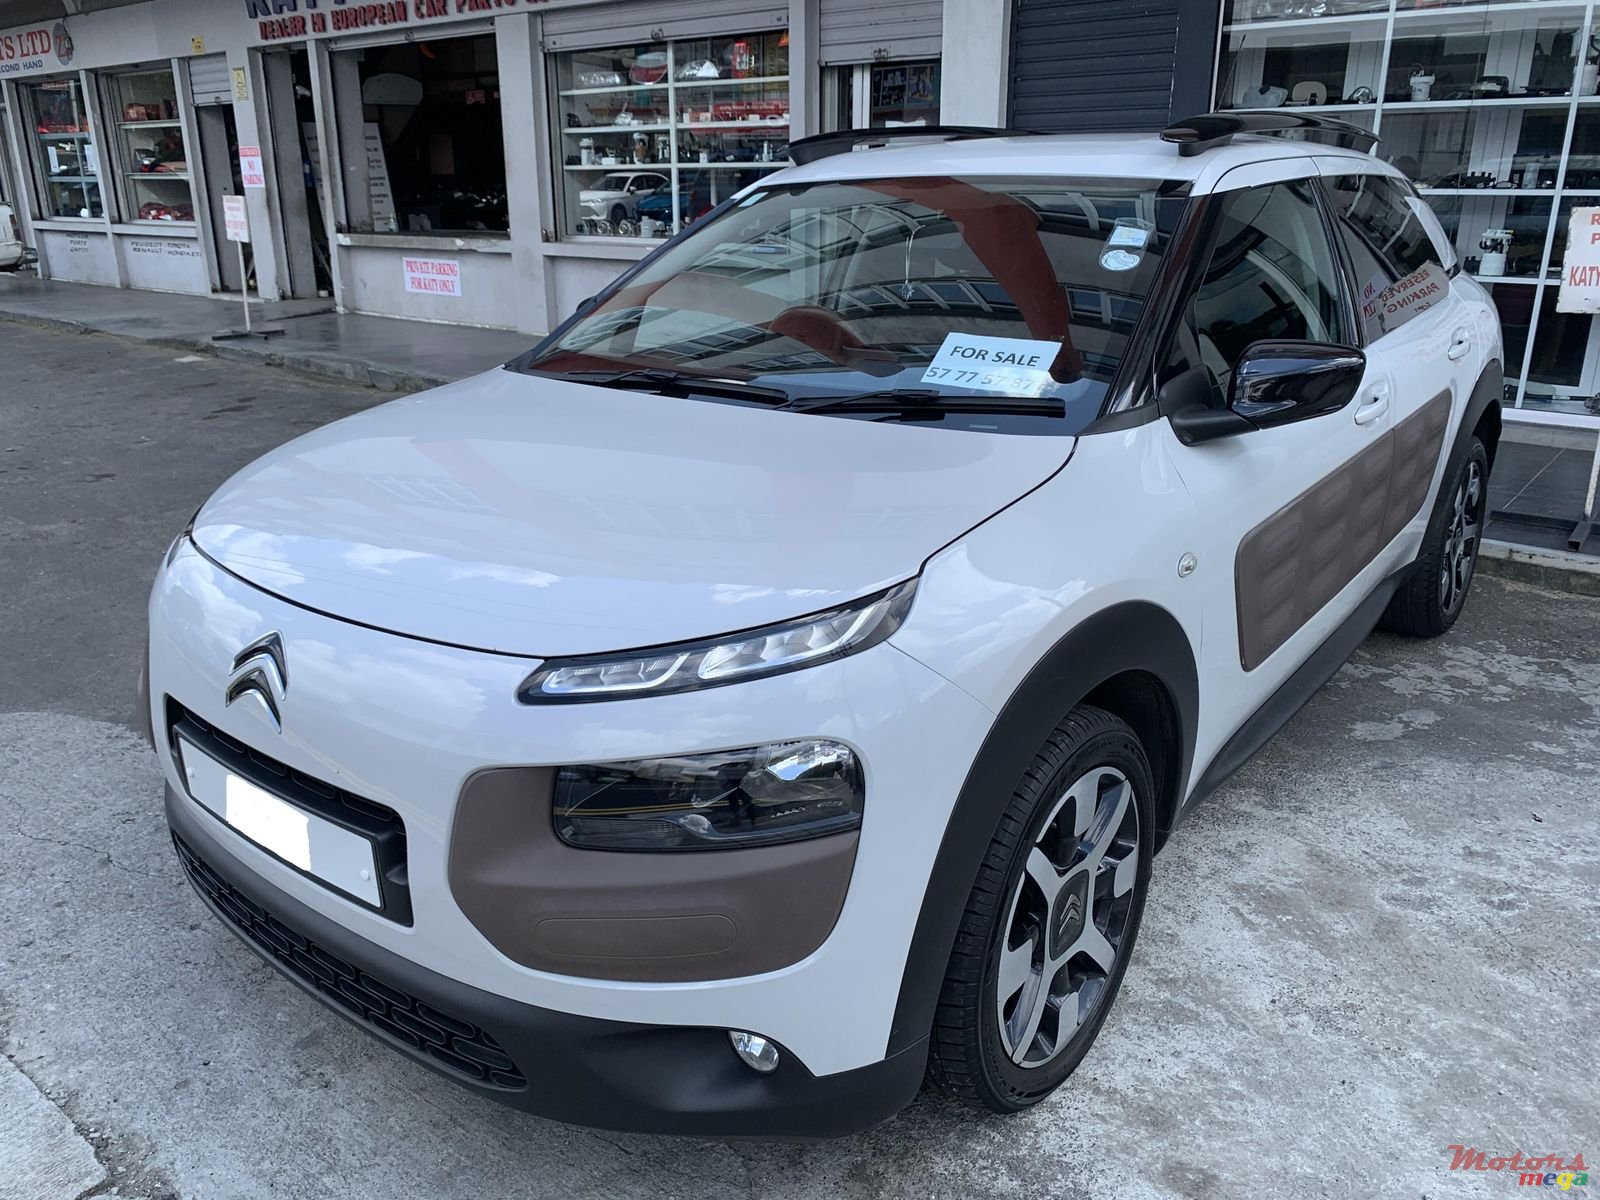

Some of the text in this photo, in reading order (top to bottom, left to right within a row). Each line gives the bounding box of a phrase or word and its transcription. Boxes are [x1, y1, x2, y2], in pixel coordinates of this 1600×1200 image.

[258, 0, 517, 40] DEALER IN EUROPEAN CAR PAR
[16, 29, 51, 57] LTD
[0, 59, 43, 73] COND HAND
[950, 345, 1040, 367] FOR SALE
[926, 366, 951, 379] 57
[954, 370, 979, 383] 77
